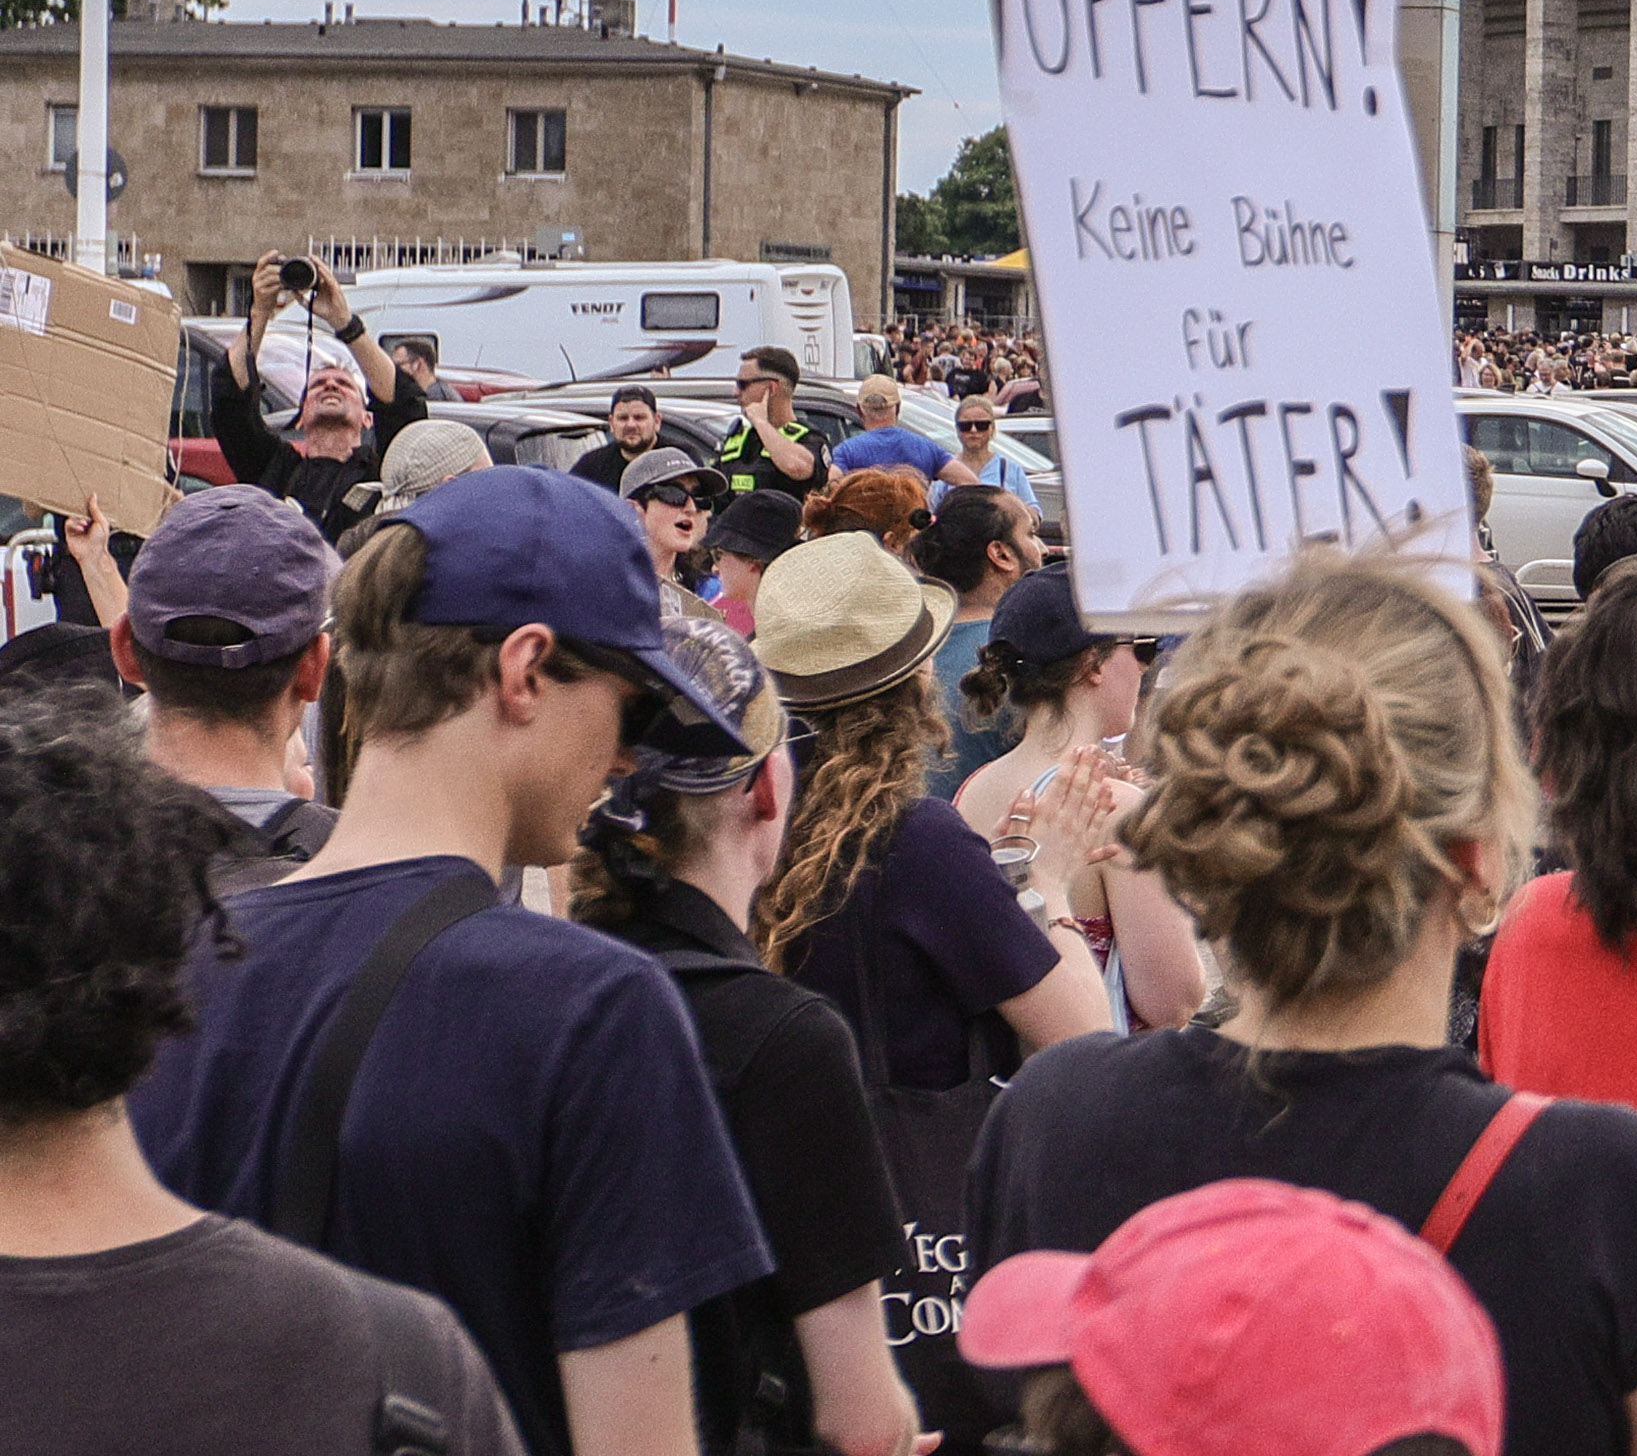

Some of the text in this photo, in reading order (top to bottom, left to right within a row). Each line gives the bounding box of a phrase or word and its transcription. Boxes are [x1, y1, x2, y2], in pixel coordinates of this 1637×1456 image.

[1070, 175, 1354, 270] Keine Bühne
[570, 302, 625, 315] FENDT
[1563, 264, 1630, 282] Drinks
[1183, 304, 1252, 376] für
[1114, 388, 1422, 558] TÄTER!
